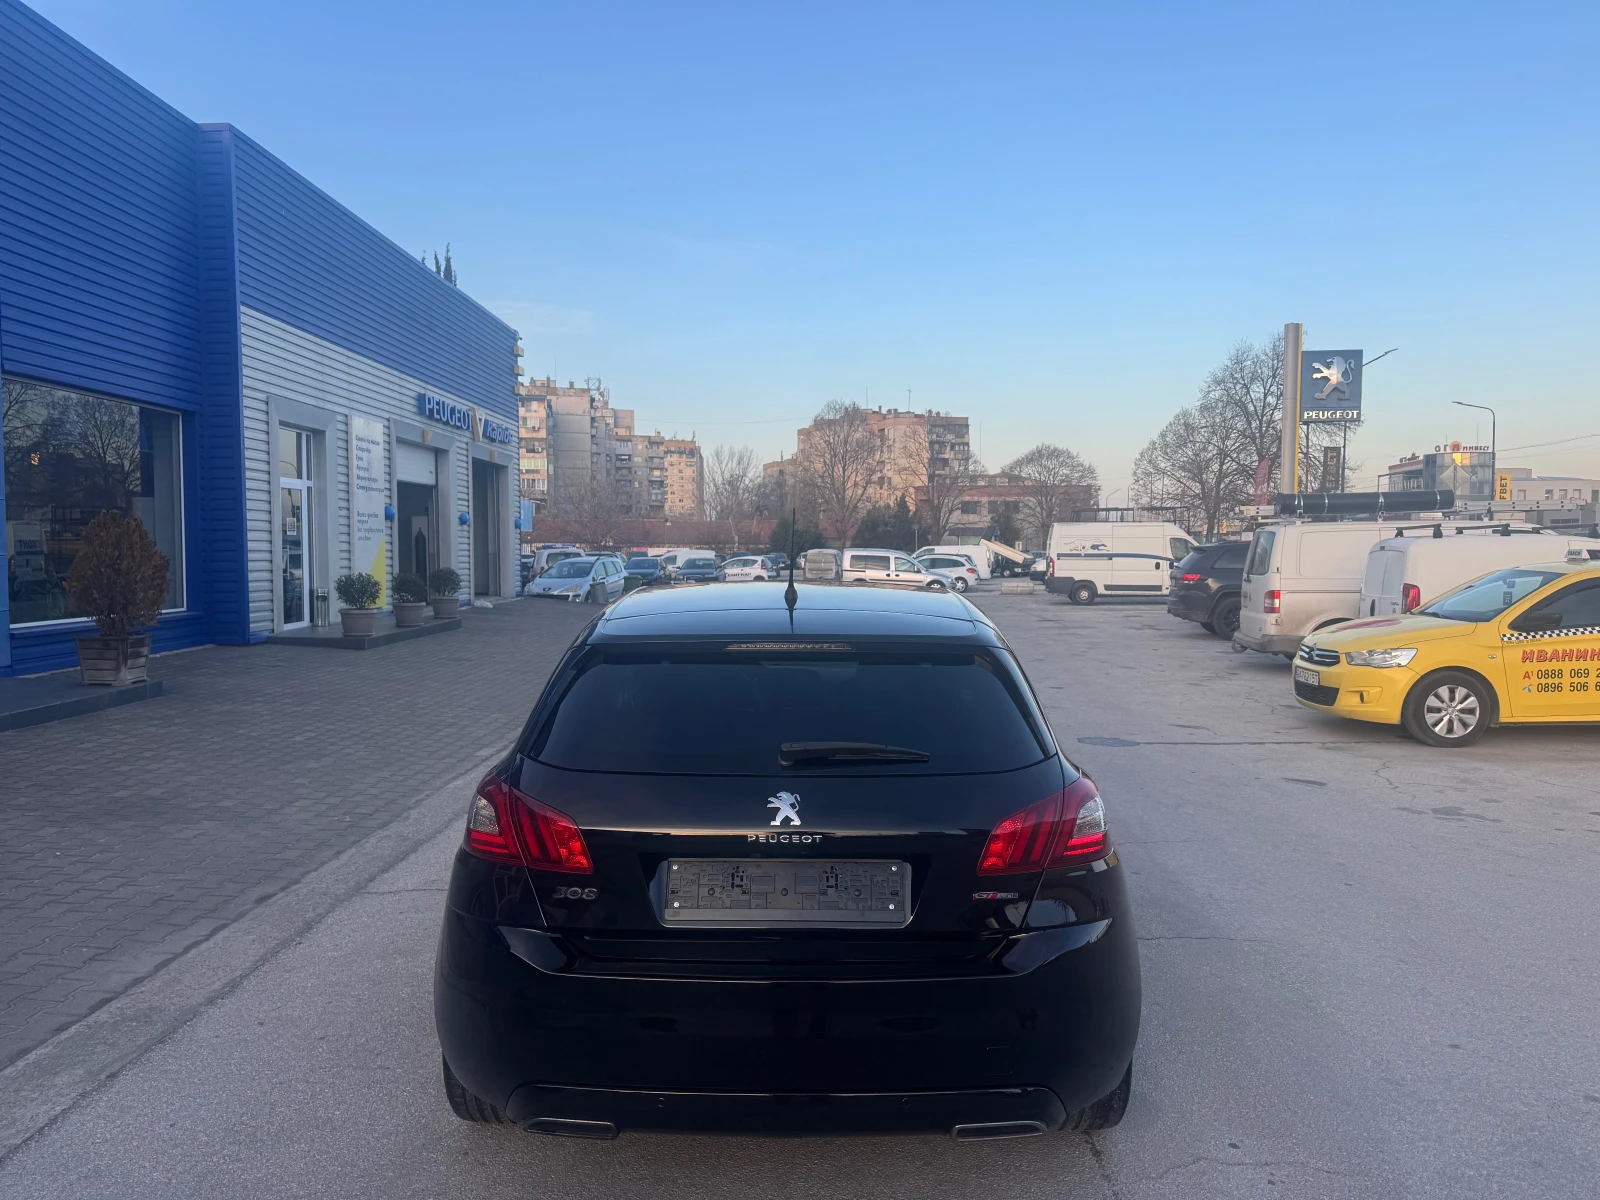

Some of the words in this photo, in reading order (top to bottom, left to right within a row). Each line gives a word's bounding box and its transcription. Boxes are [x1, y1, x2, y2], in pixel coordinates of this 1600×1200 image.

[425, 394, 473, 430] PEUGEOT
[1304, 410, 1360, 419] PEUGEOT
[1536, 669, 1564, 680] 0888
[1569, 668, 1590, 679] 069
[1536, 682, 1563, 693] 0896
[1569, 681, 1589, 692] 506
[747, 834, 823, 843] PEUGEOT
[551, 886, 598, 900] 308
